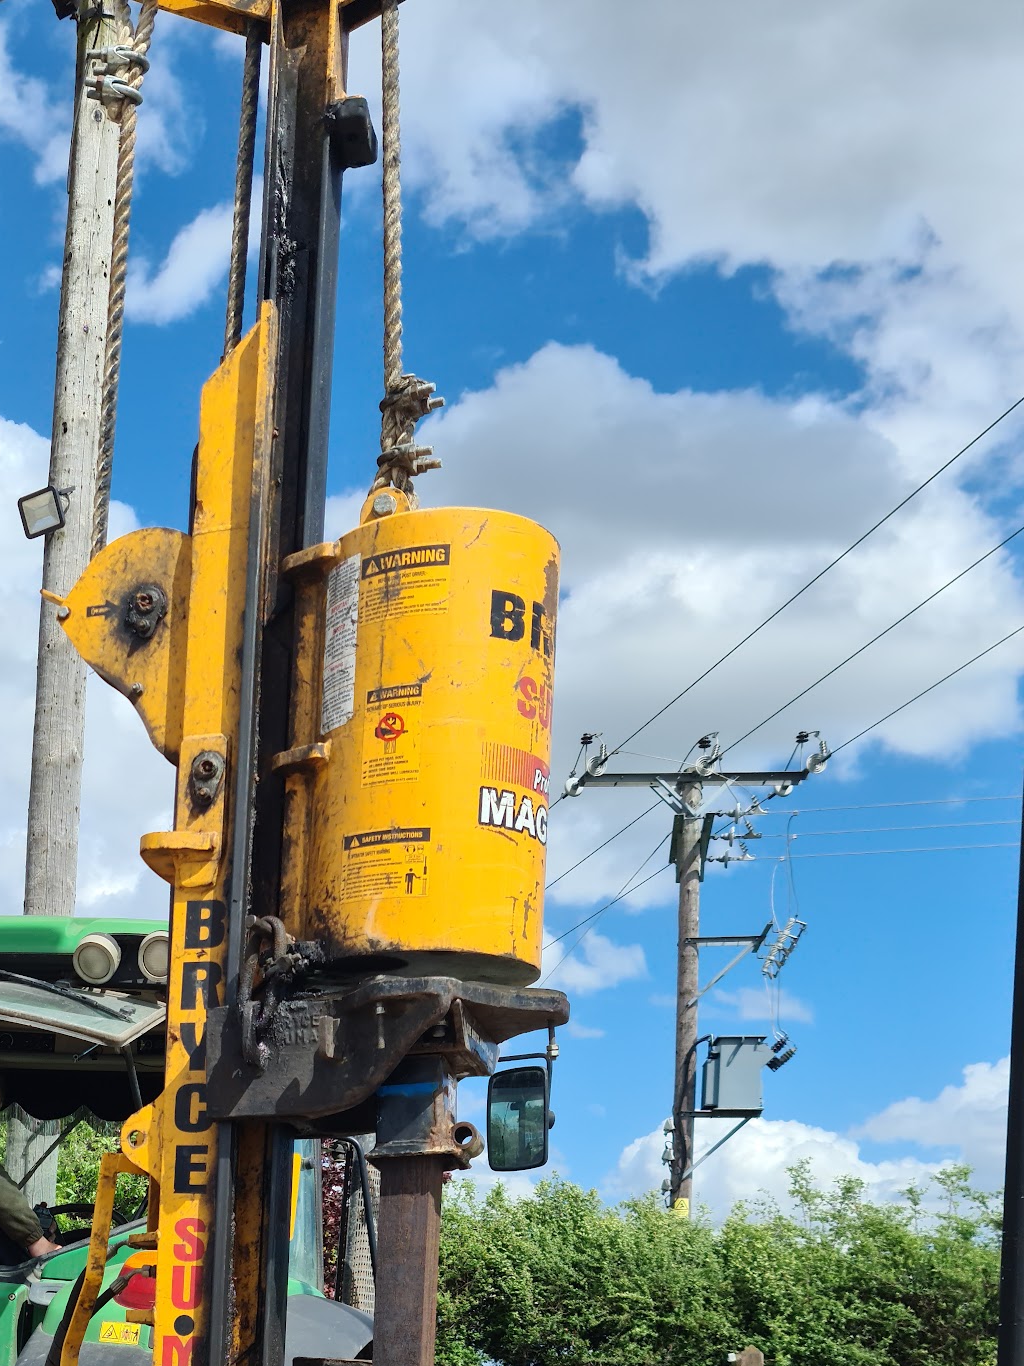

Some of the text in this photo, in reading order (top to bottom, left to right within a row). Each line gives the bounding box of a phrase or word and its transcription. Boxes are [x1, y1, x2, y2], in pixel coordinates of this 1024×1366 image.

[379, 548, 446, 570] WARNING
[380, 686, 420, 699] WARNING
[478, 787, 549, 845] MAG
[361, 831, 423, 844] SAFETY INSTRUCTIONS
[174, 900, 226, 1194] BRYCE
